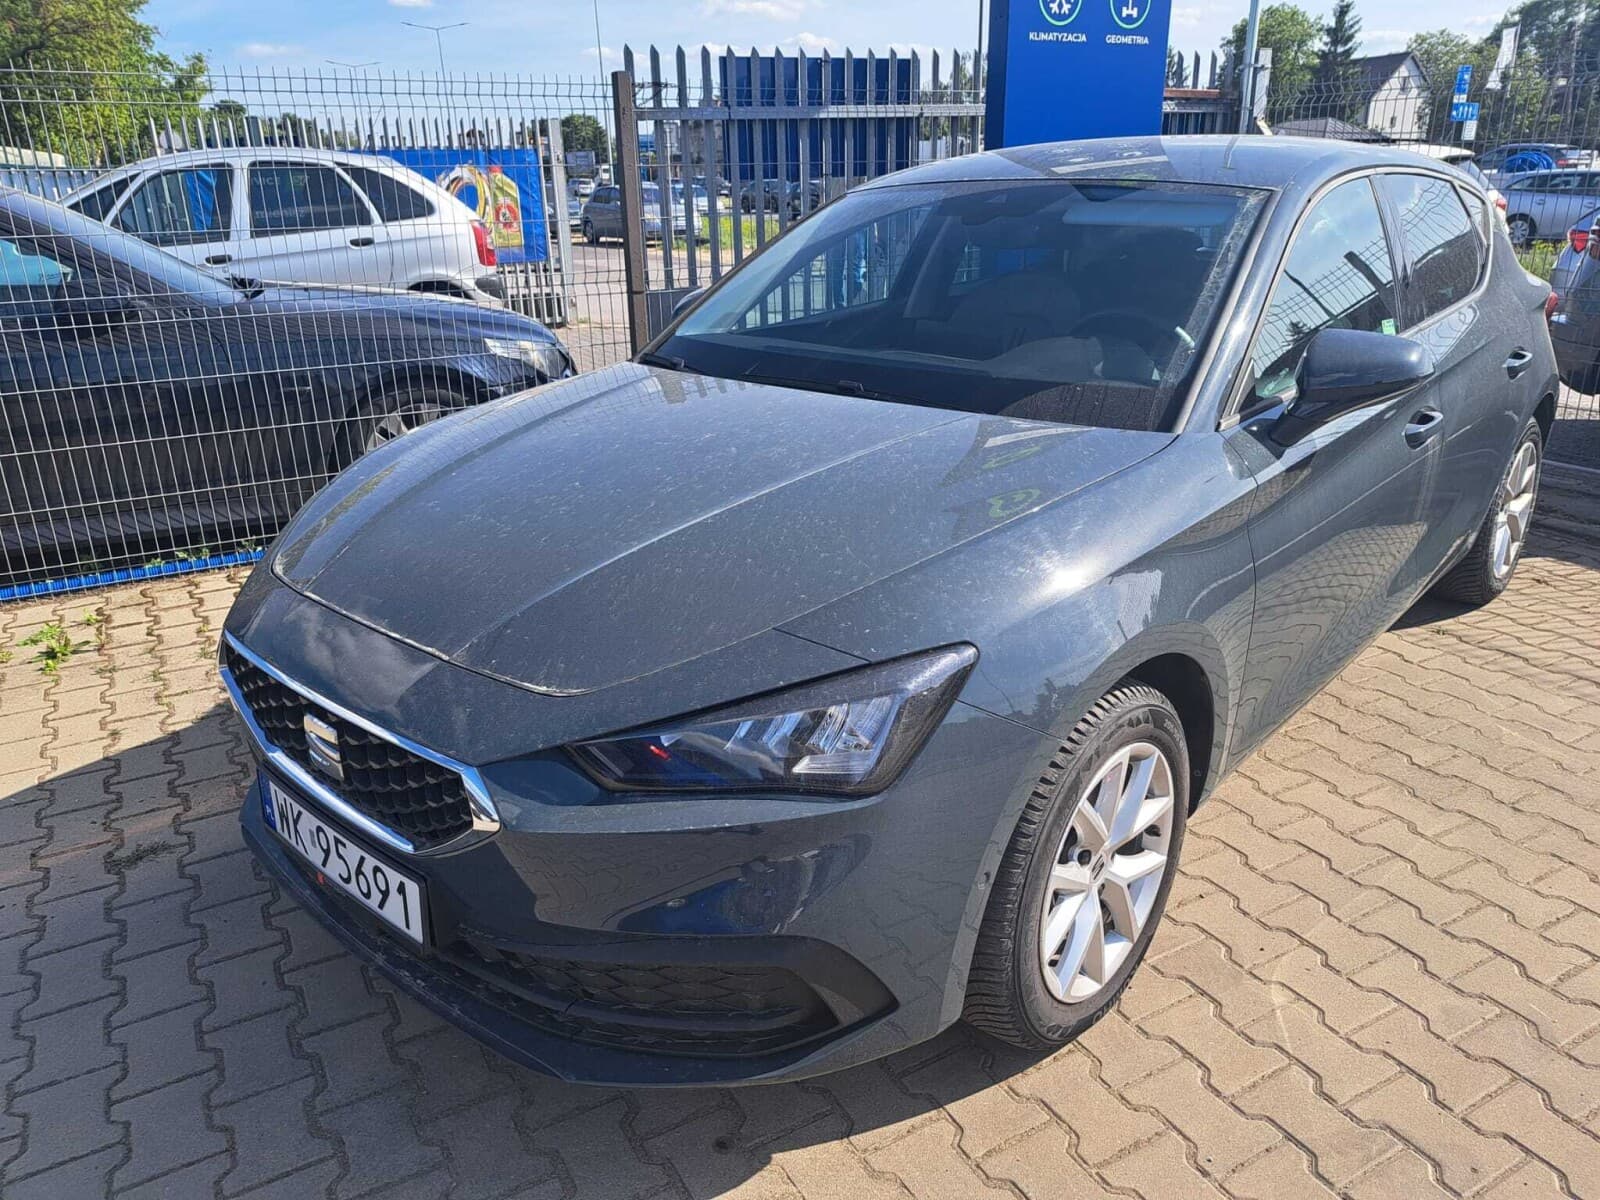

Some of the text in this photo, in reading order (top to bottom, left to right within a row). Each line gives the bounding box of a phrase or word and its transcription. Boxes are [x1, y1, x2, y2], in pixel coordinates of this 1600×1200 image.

[1029, 31, 1088, 43] KLIMATYZACJA
[1105, 34, 1149, 45] GEOMETRIA
[274, 788, 411, 930] WK 95691
